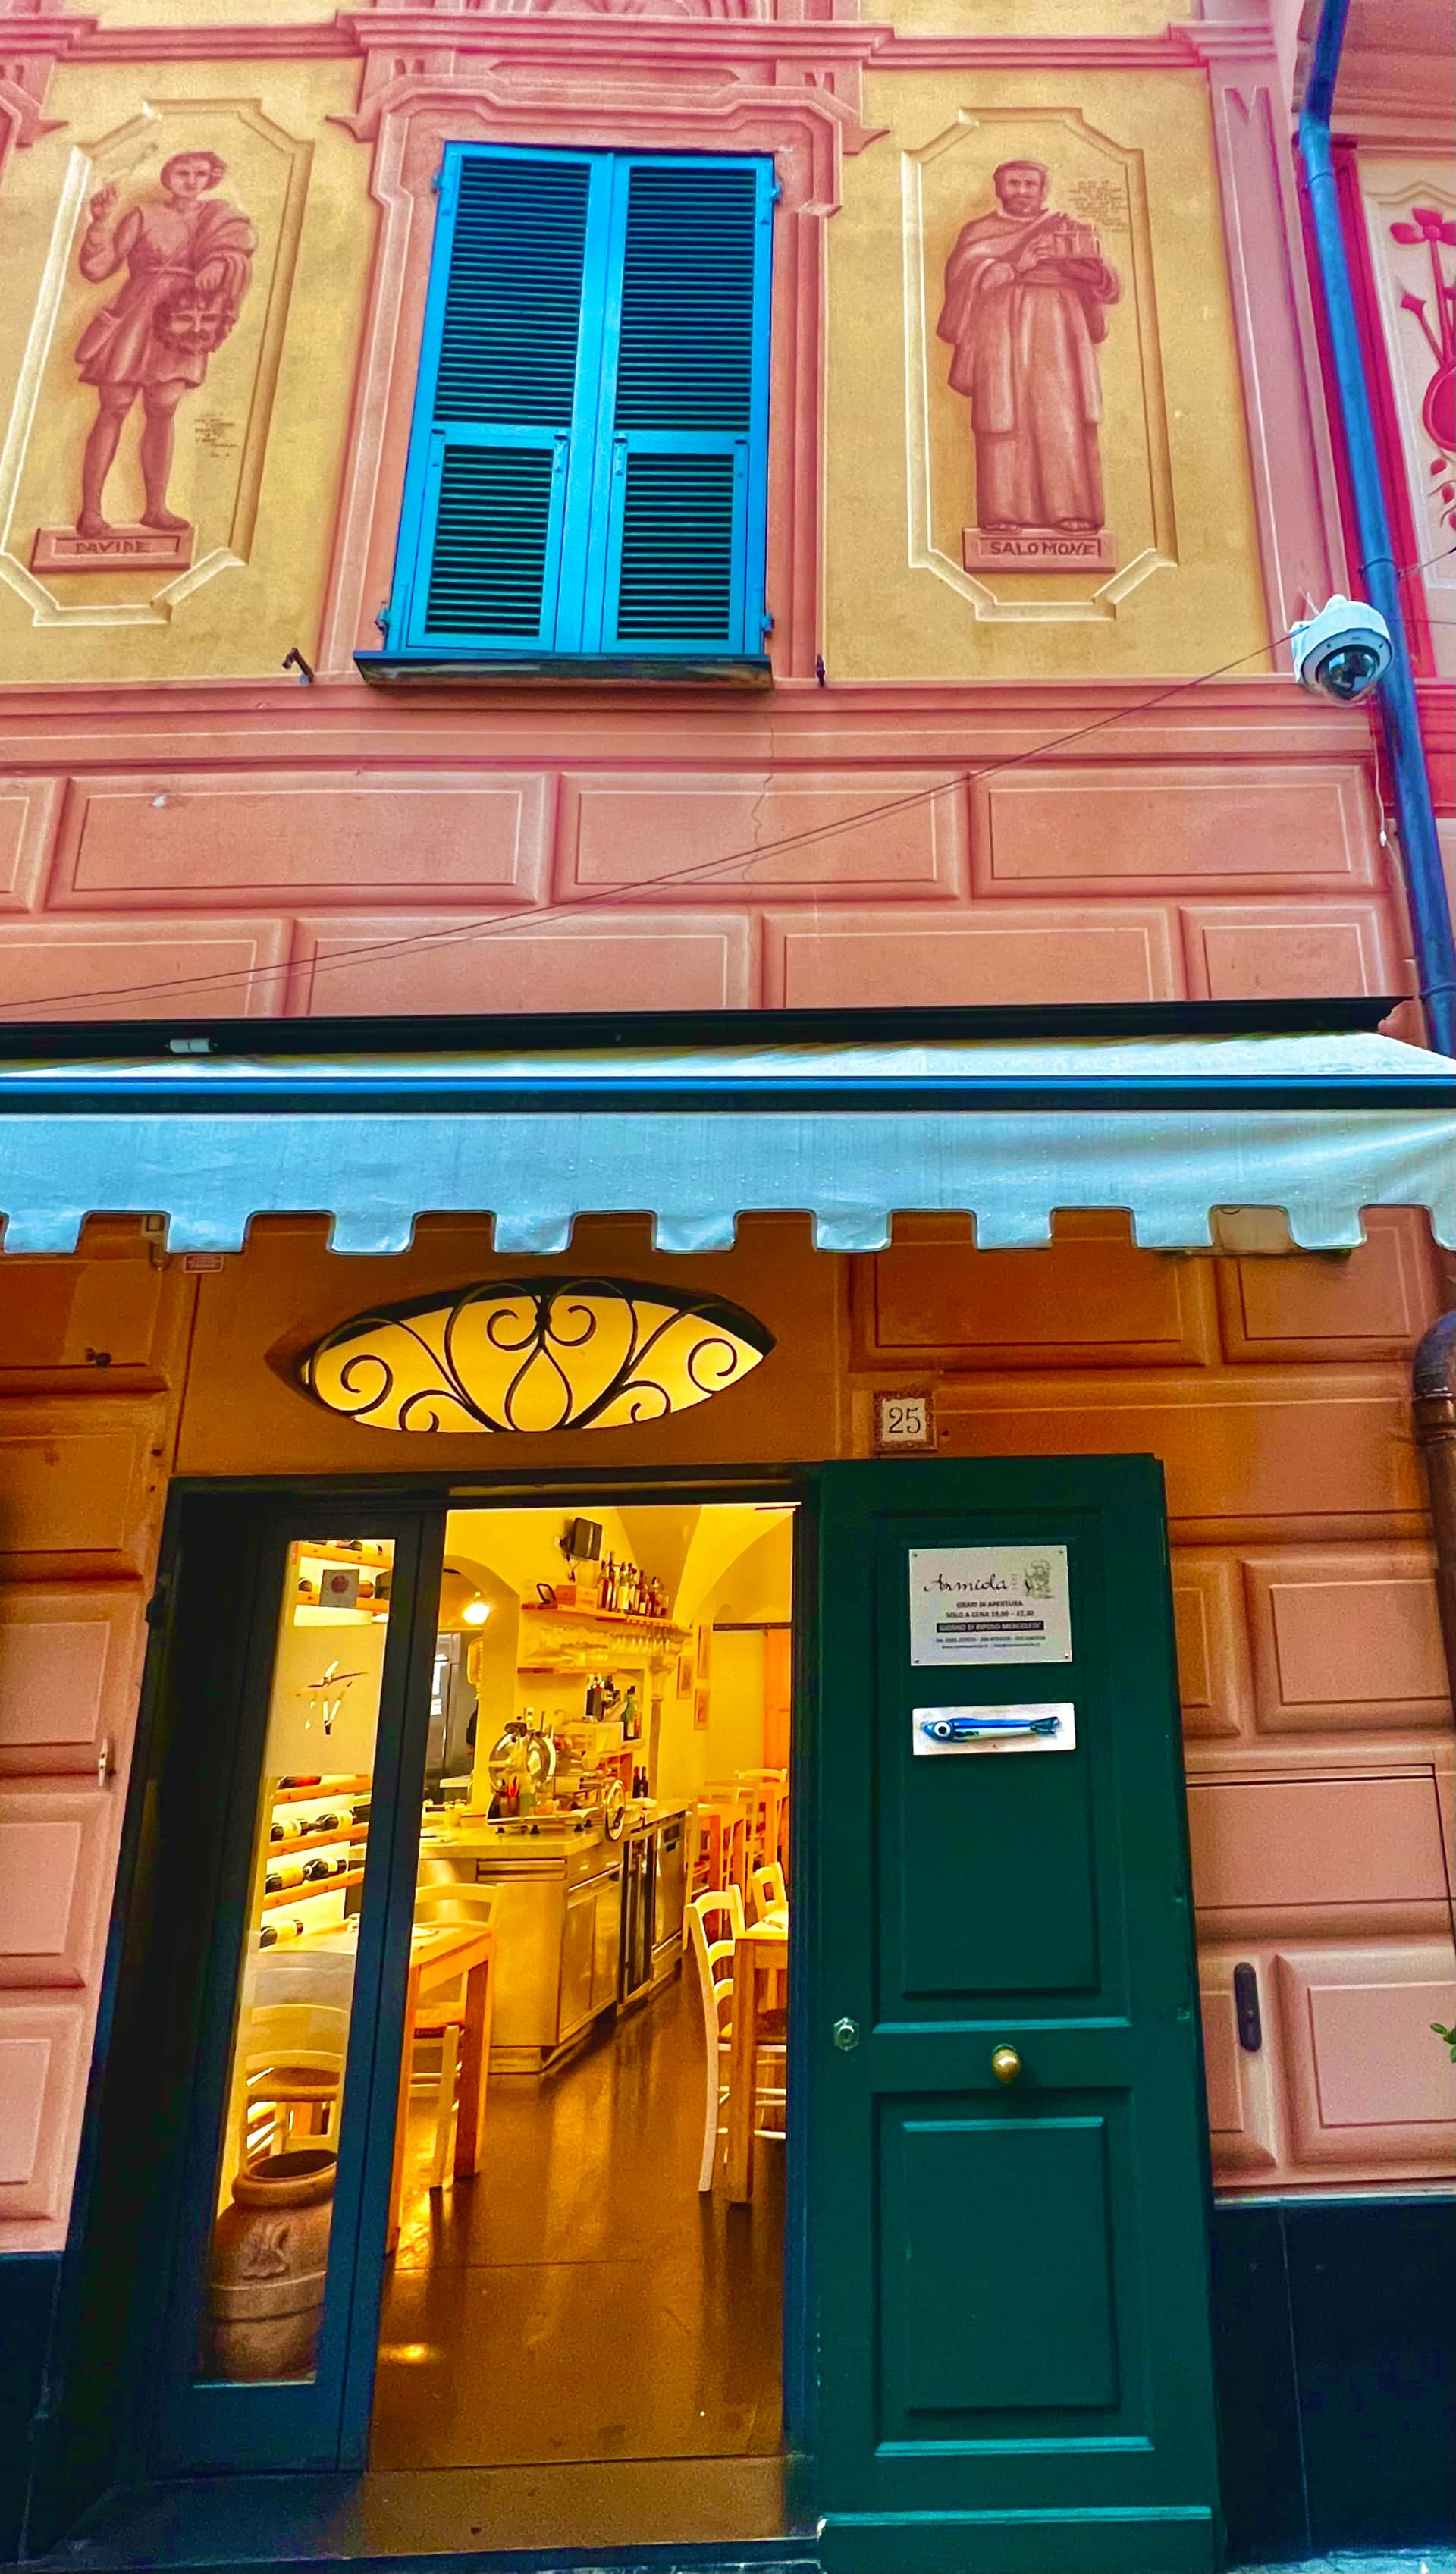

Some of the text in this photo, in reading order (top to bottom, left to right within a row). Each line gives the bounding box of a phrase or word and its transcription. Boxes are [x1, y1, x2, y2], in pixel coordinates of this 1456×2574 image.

[76, 540, 150, 554] DAVIDE
[990, 541, 1096, 556] SALOMONE
[888, 1407, 921, 1433] 25
[924, 1573, 1008, 1592] Armida
